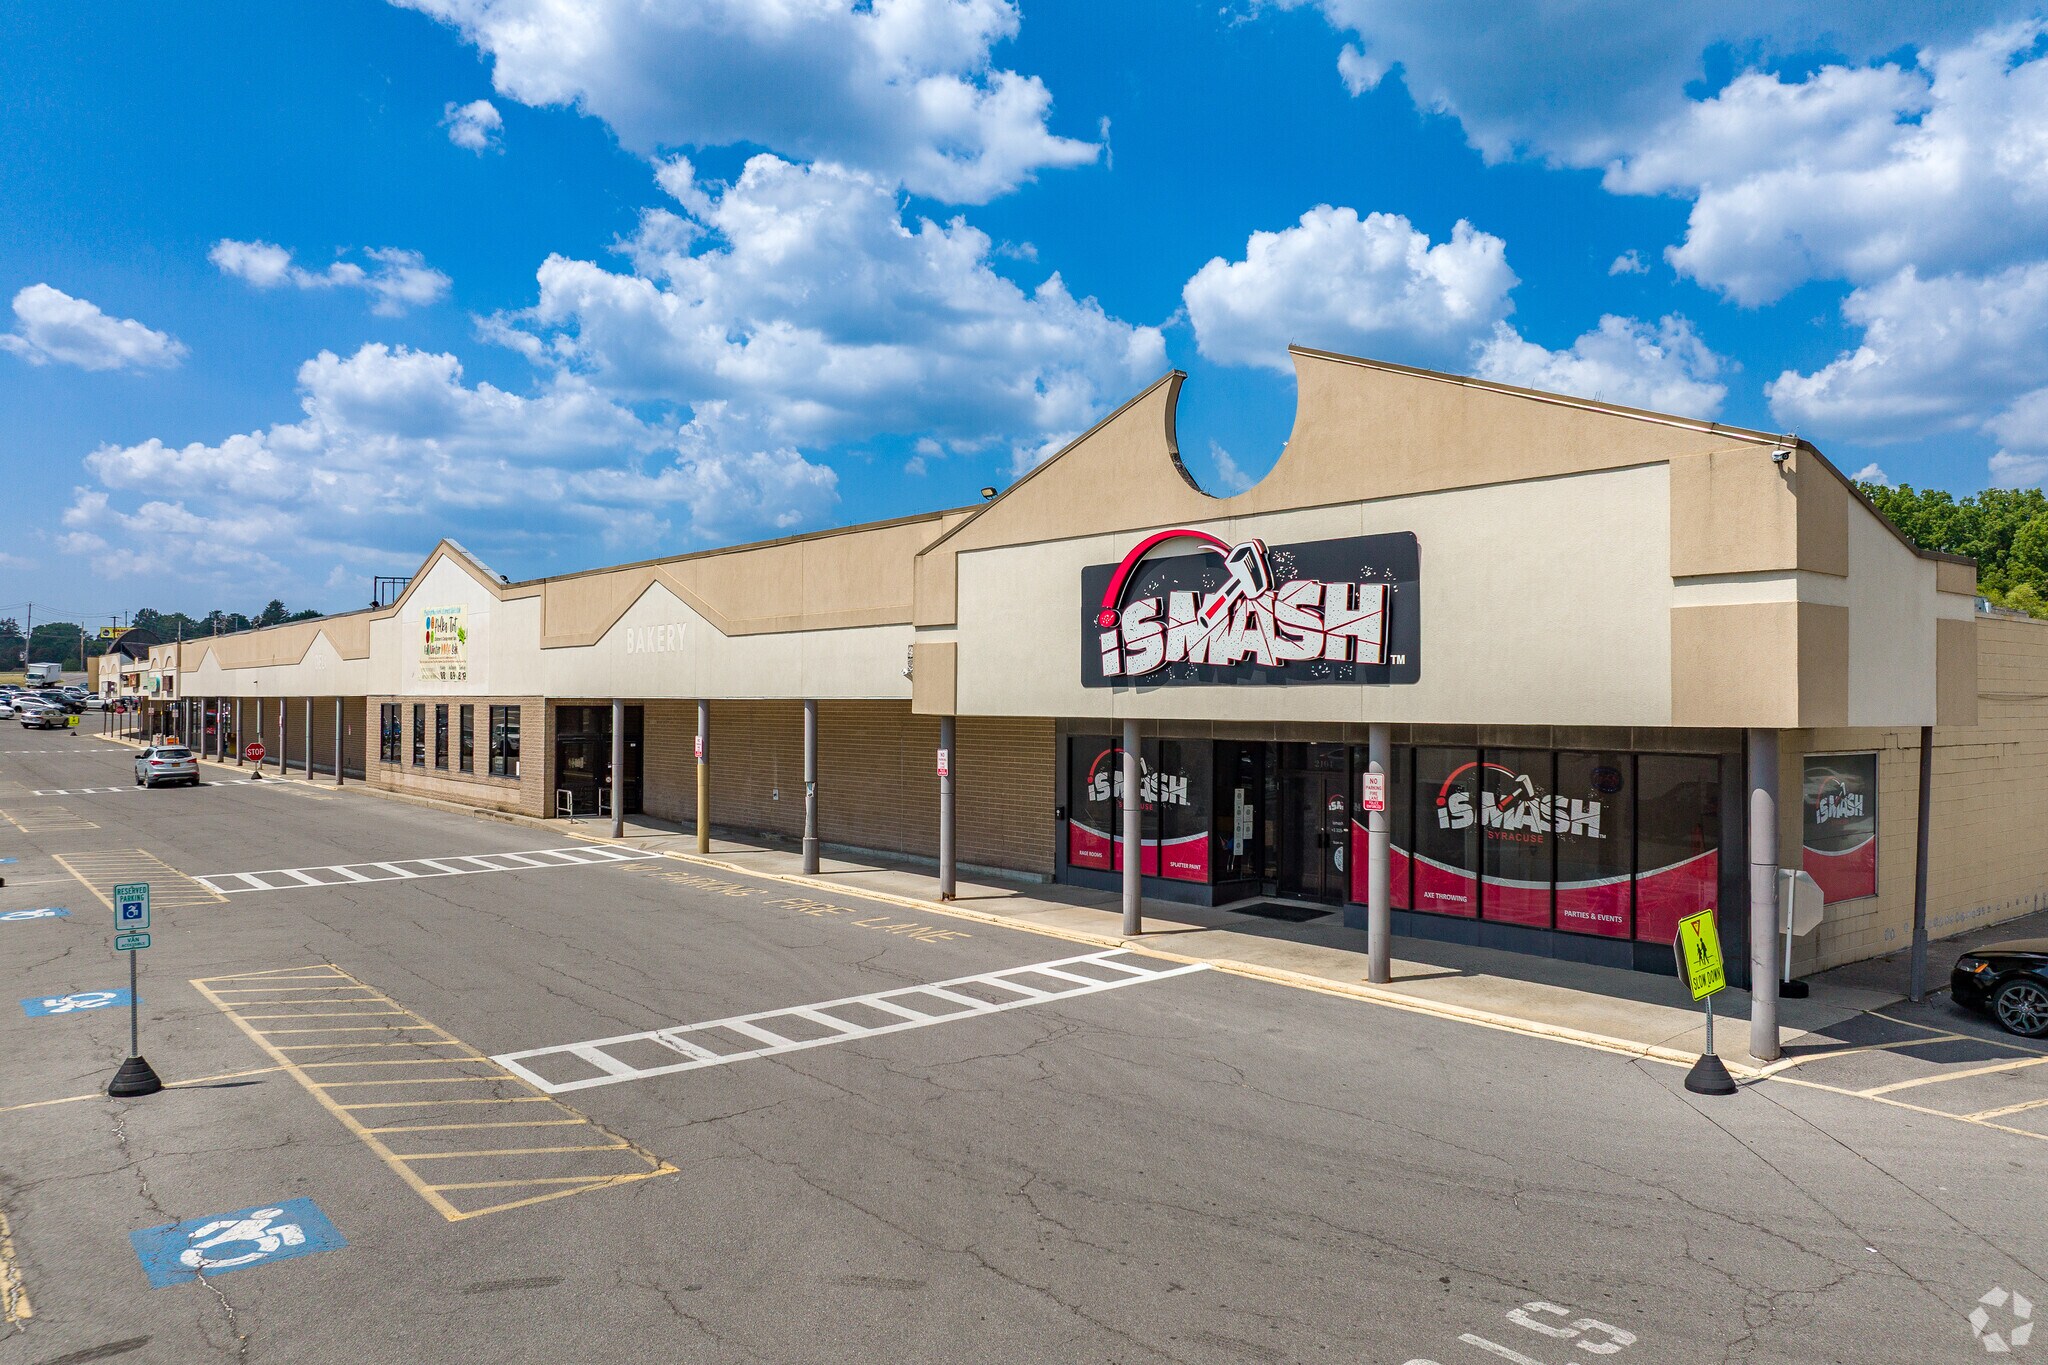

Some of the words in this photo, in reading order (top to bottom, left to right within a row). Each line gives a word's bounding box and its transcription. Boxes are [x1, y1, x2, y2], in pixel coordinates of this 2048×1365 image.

[626, 622, 688, 654] BAKERY
[247, 748, 264, 756] STOP
[1118, 802, 1153, 811] SUSE
[1488, 831, 1544, 843] SYRACUSE
[1170, 861, 1189, 869] SPLATTER
[117, 886, 147, 896] RESERVED
[1424, 891, 1435, 899] AXE
[1436, 892, 1468, 902] THROWING
[120, 894, 145, 902] PARKING
[1564, 910, 1590, 919] PARTIES
[1597, 913, 1623, 923] EVENTS
[850, 916, 973, 943] LANE
[1693, 975, 1707, 990] SLOW
[1707, 967, 1722, 985] DOWN
